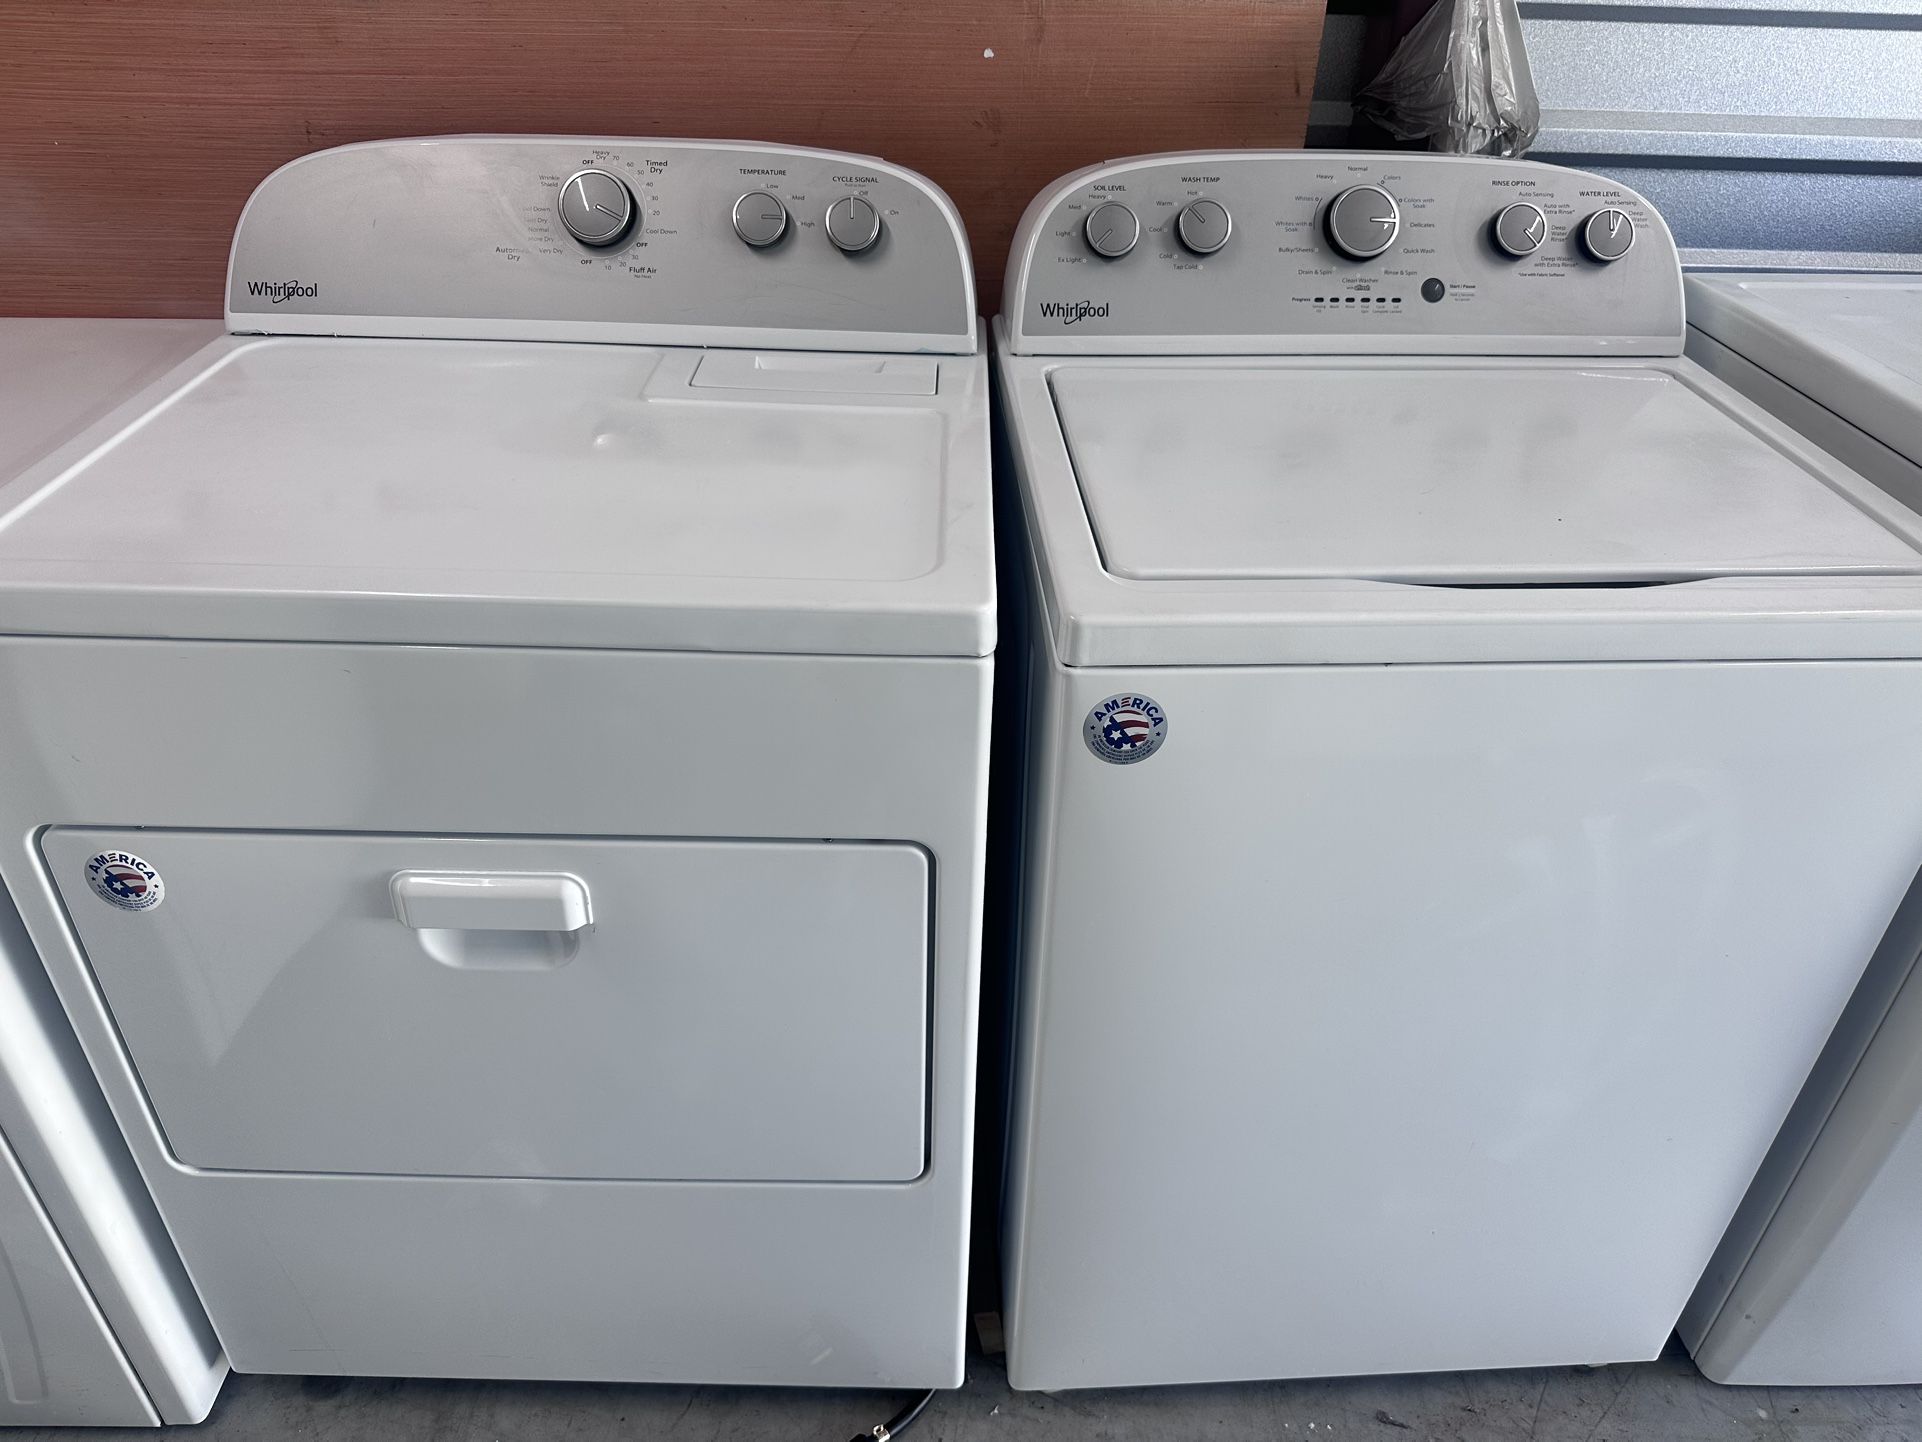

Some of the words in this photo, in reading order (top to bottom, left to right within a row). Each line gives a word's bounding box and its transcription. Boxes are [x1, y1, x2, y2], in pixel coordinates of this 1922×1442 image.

[248, 280, 318, 303] Whirlpool
[1040, 300, 1109, 324] Whirlpool
[1094, 697, 1163, 727] AMERICA
[88, 853, 155, 880] AMERICA
